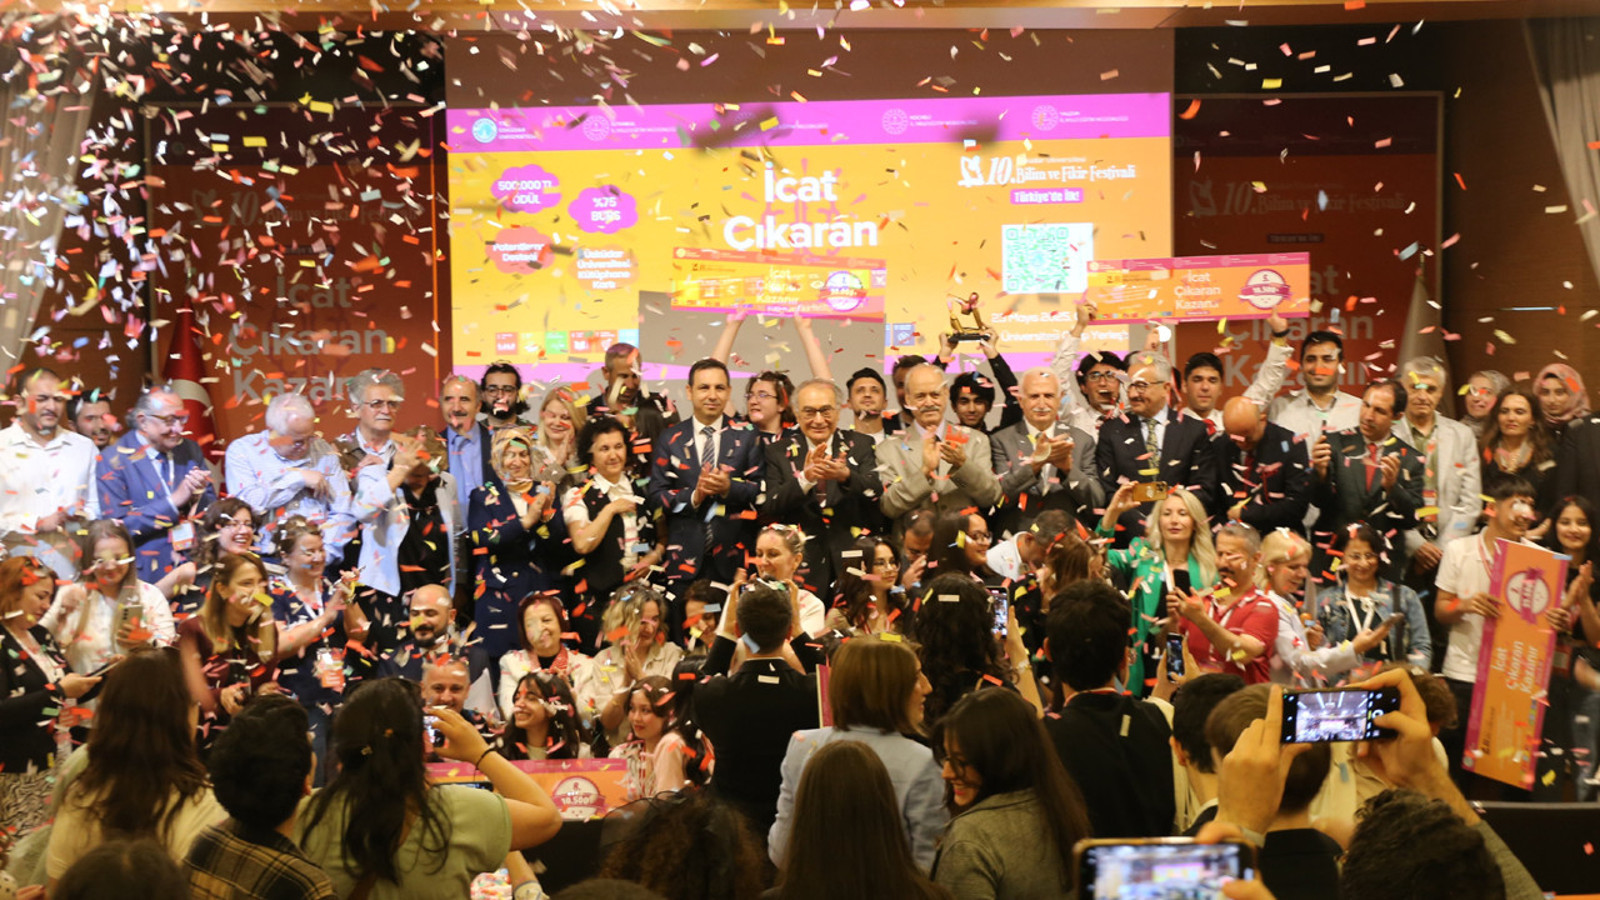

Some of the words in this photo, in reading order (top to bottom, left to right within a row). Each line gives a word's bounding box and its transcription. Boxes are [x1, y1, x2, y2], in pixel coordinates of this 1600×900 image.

[764, 161, 838, 203] İcat
[1048, 170, 1060, 180] ve
[1310, 265, 1339, 296] at
